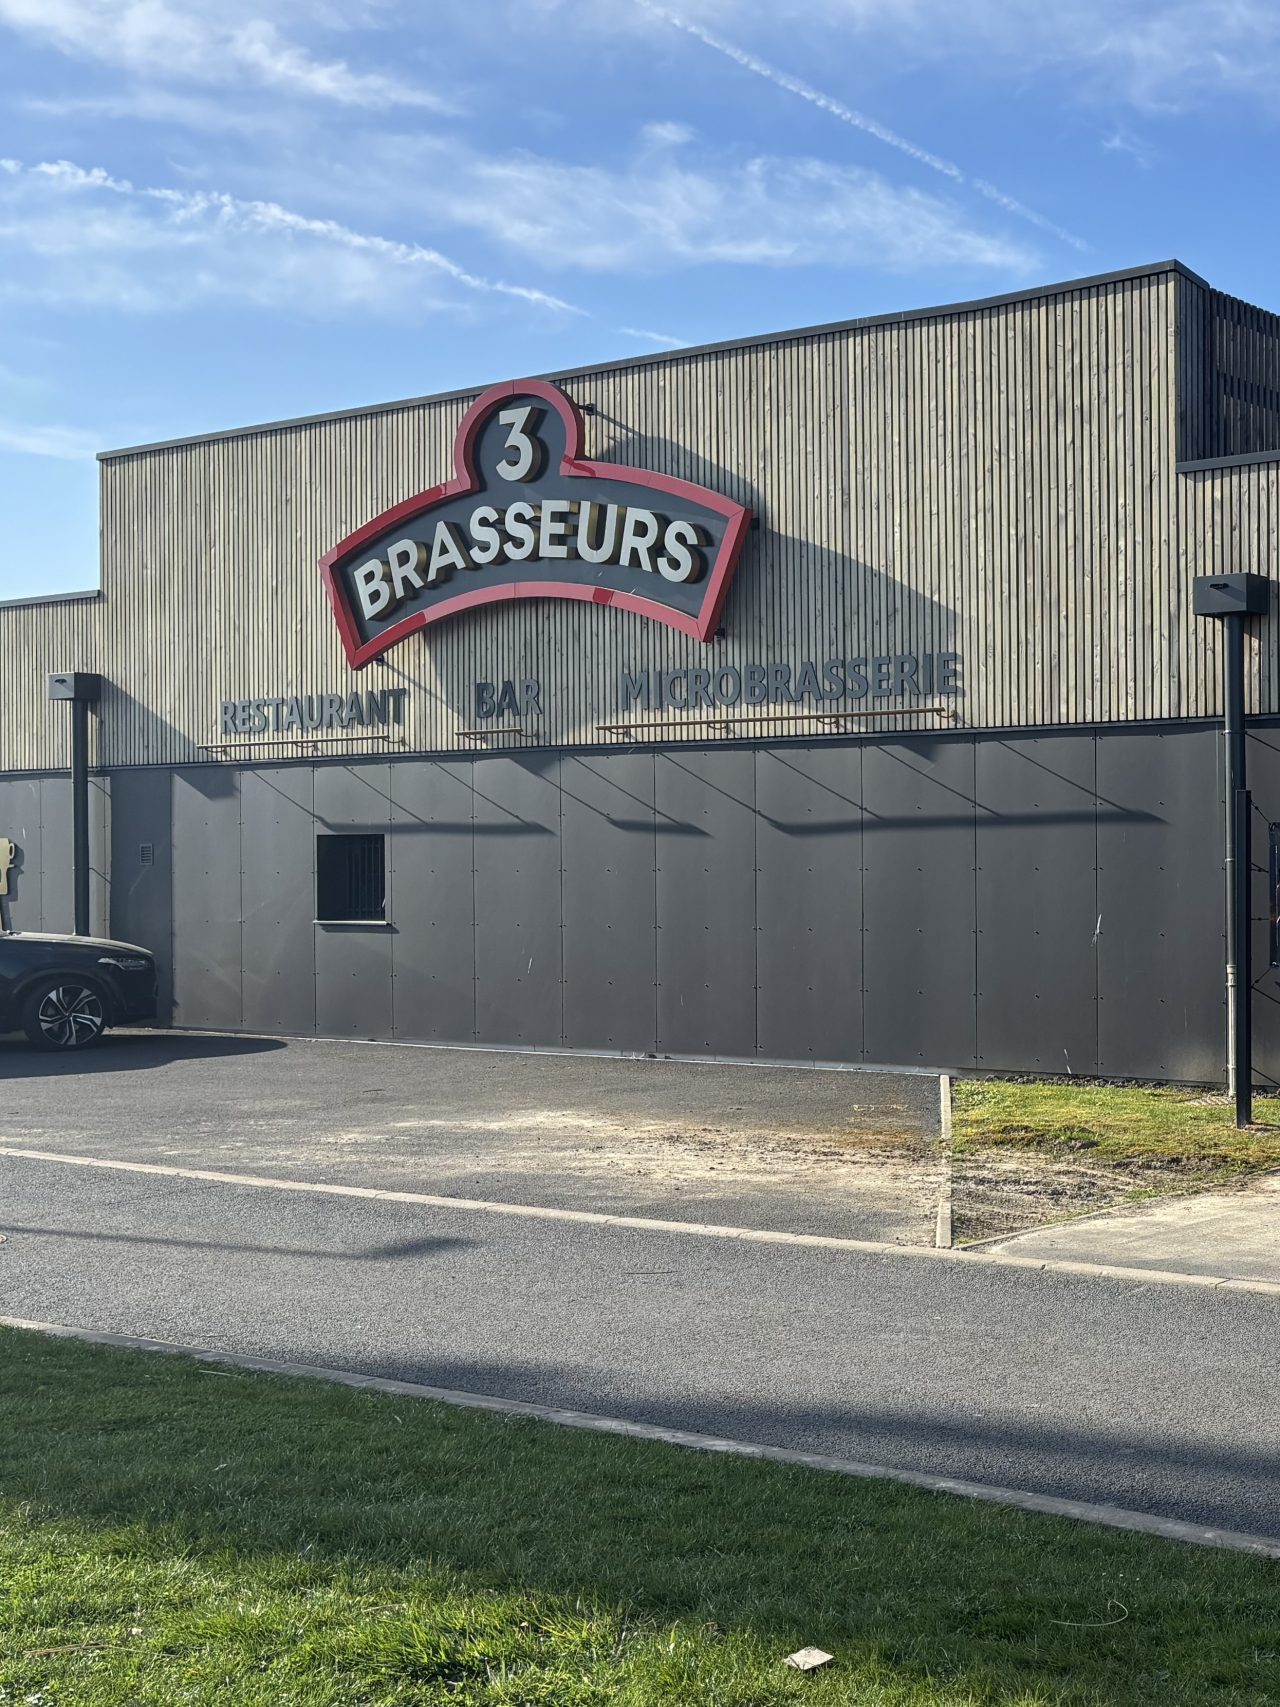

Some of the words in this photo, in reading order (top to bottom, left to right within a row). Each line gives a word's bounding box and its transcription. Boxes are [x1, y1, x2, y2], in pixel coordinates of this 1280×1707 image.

[496, 406, 536, 482] 3
[353, 499, 701, 621] BRASSEURS
[219, 688, 407, 734] RESTAURANT
[476, 678, 543, 719] BAR
[620, 652, 960, 711] MICROBRASSERIE
